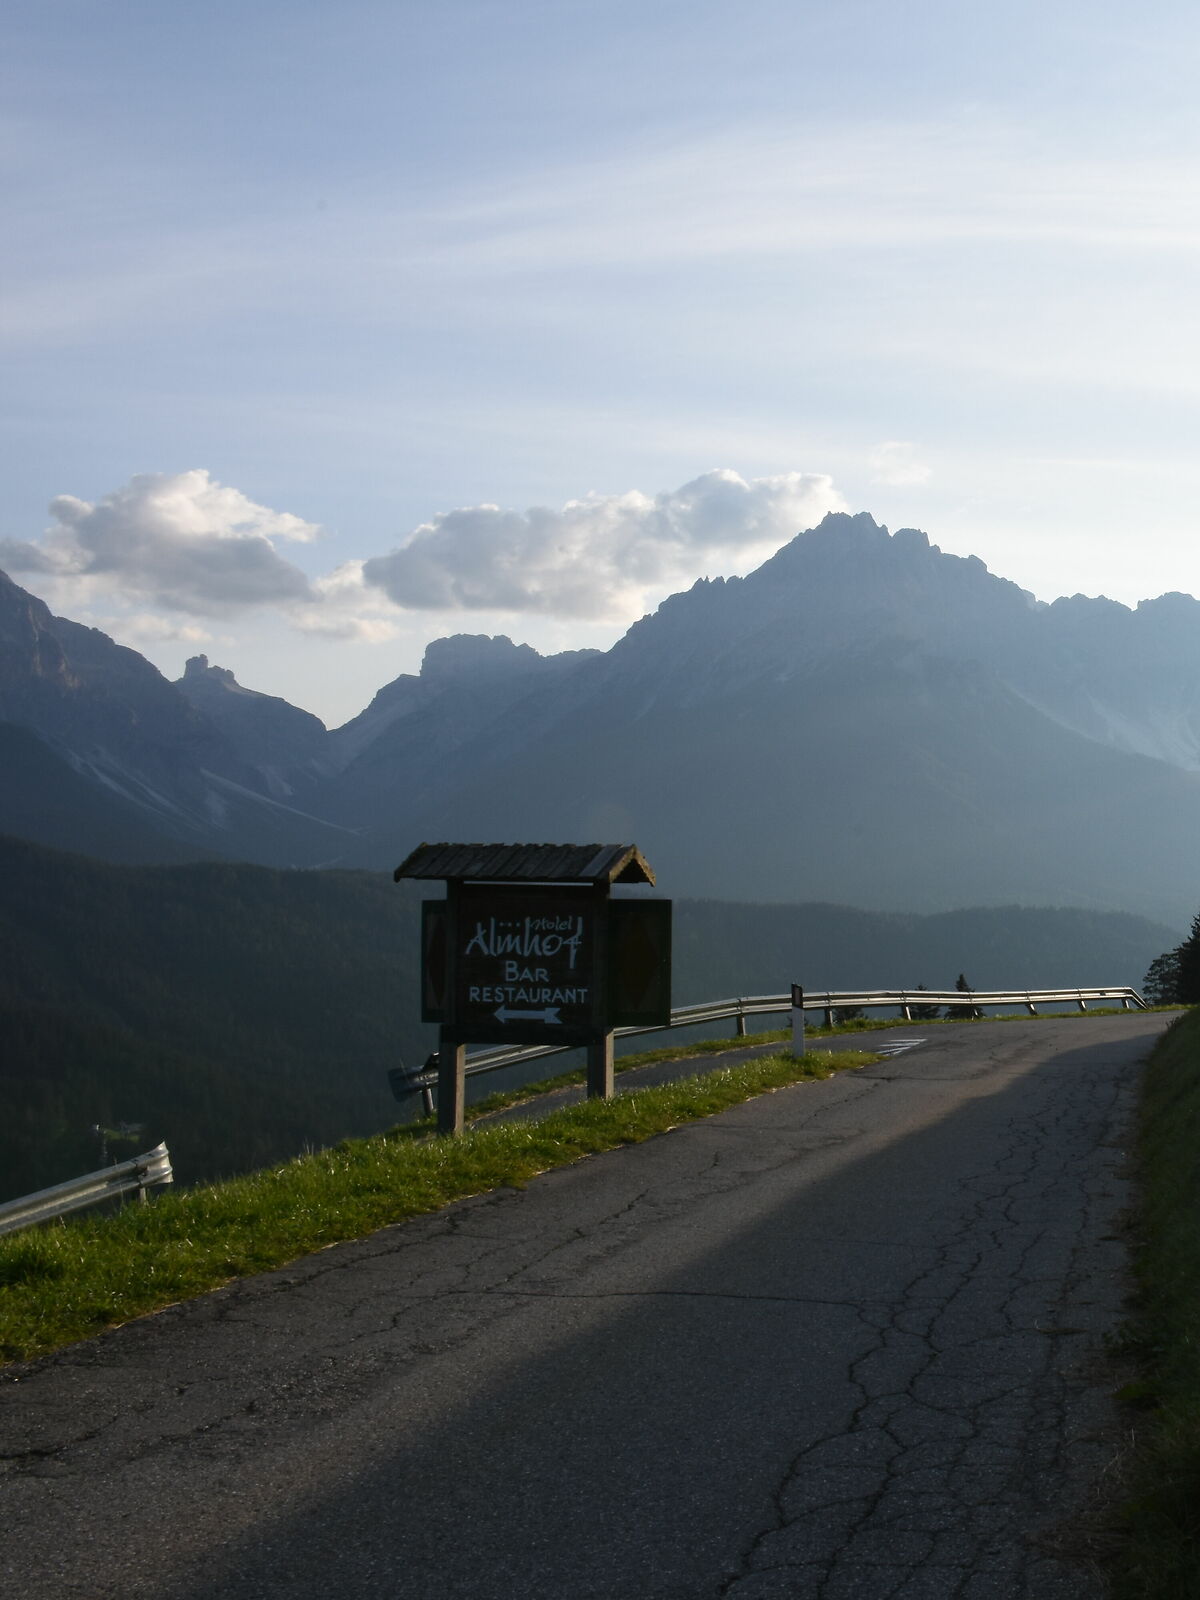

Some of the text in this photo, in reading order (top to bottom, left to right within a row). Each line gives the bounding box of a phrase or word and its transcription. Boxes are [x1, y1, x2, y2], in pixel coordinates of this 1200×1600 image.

[531, 915, 573, 931] Hotel
[464, 916, 583, 969] Almhof
[469, 986, 589, 1004] RESTAURANT
